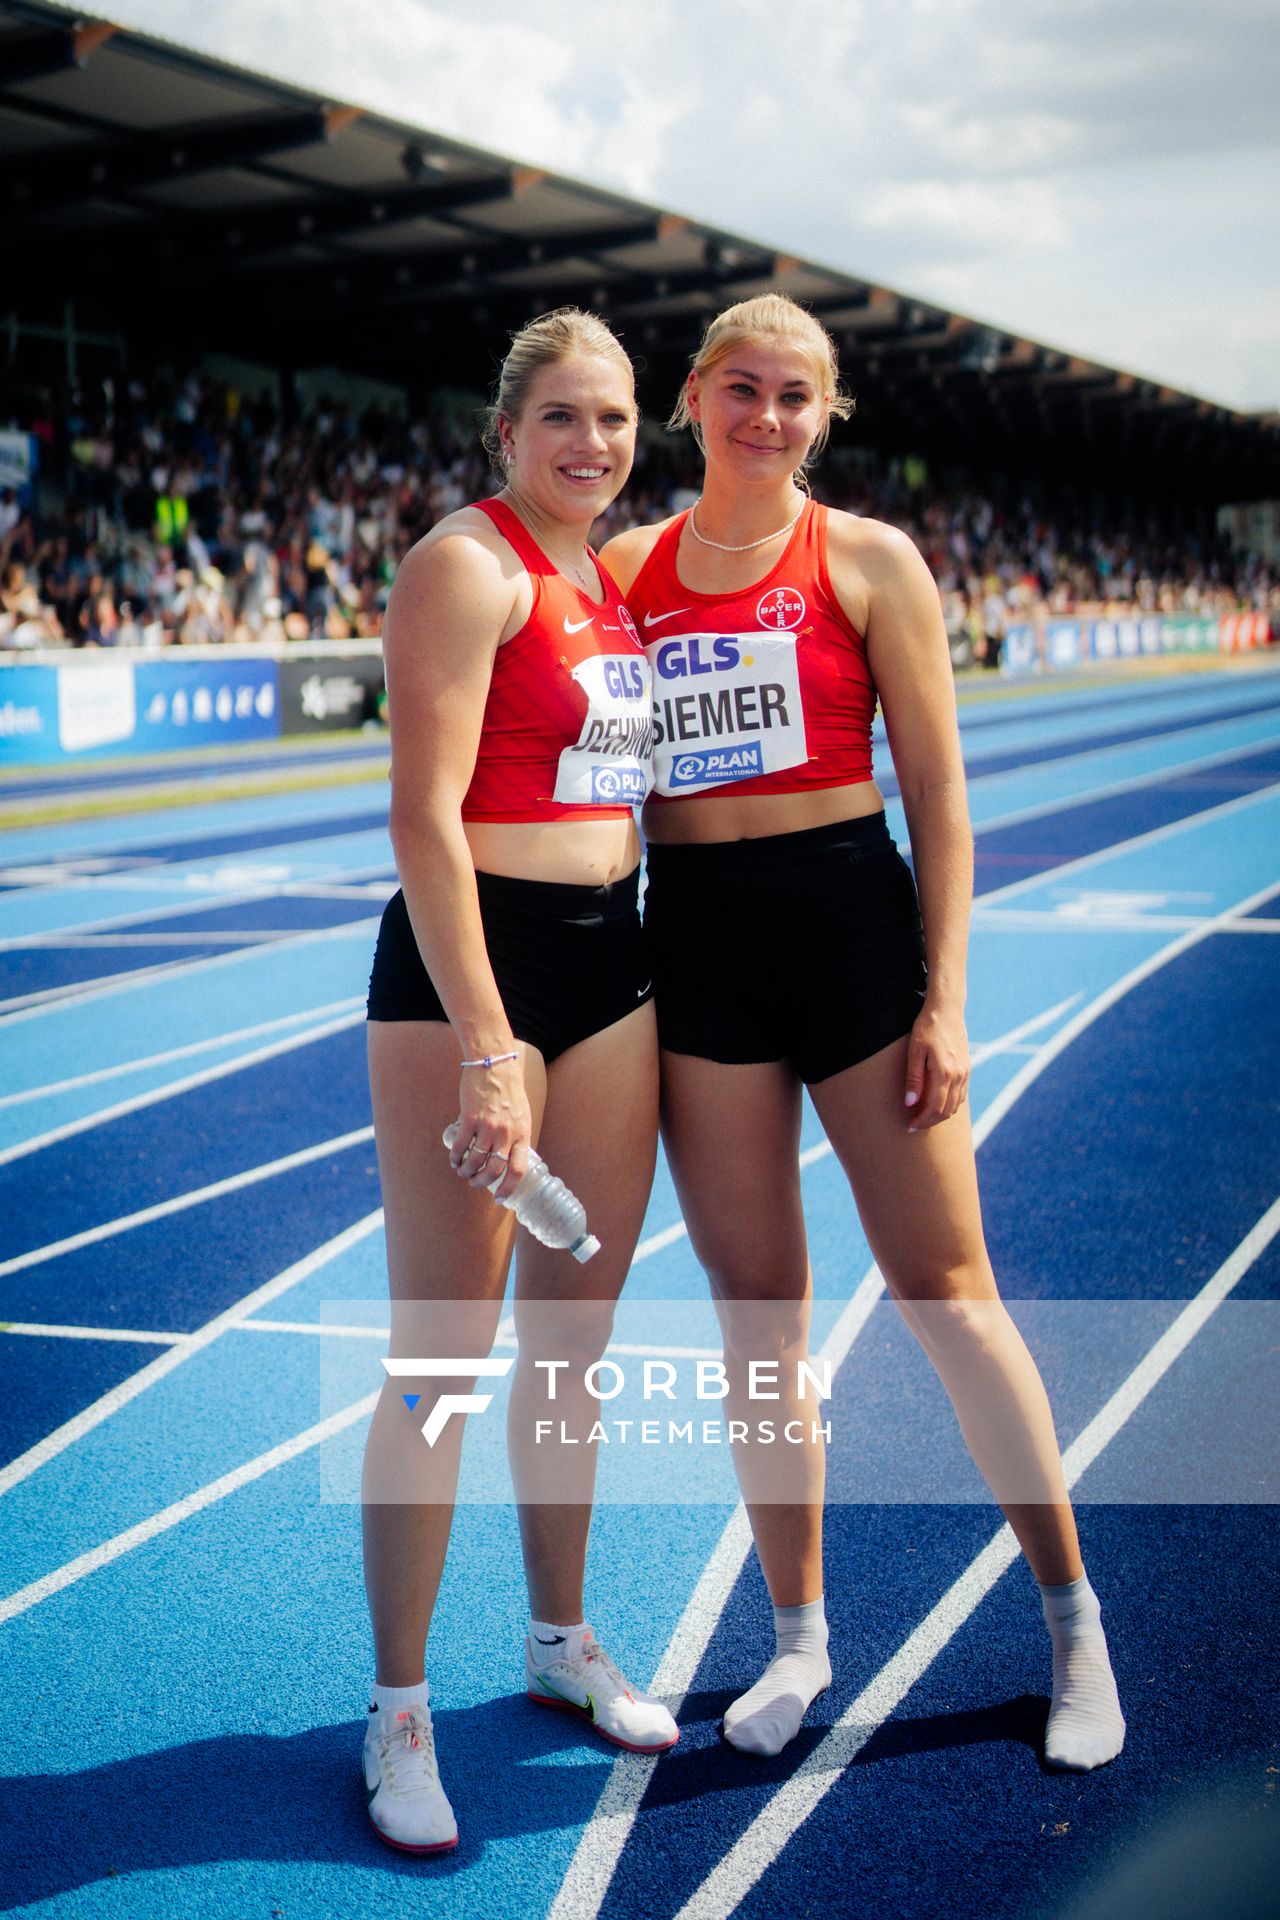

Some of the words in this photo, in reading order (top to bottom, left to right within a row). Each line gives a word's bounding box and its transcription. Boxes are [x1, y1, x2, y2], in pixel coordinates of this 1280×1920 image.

[760, 602, 802, 615] BAYER
[777, 590, 786, 627] BAYER
[651, 683, 790, 747] SIEMER
[706, 750, 759, 771] PLAN
[704, 768, 760, 779] INTERNATIONAL
